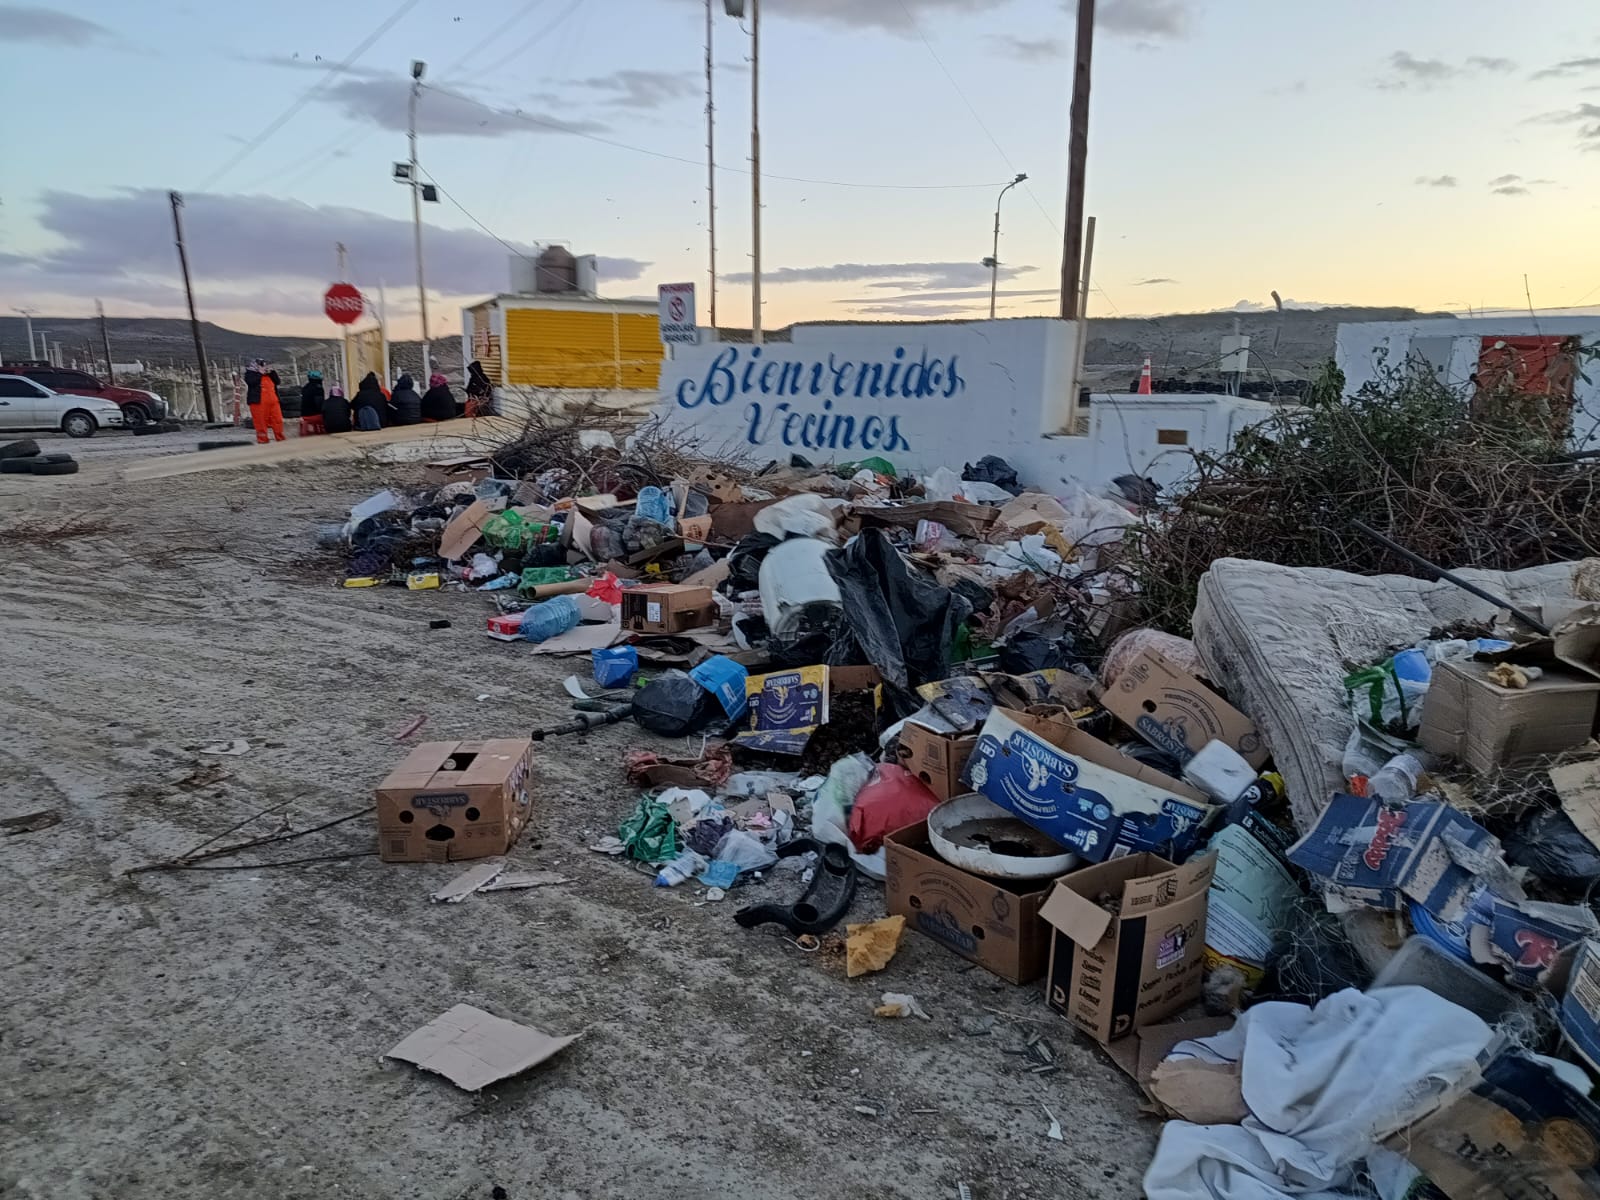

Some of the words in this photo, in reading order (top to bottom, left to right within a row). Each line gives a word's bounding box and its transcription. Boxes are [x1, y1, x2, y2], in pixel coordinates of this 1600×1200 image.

[326, 296, 362, 311] PARE
[676, 346, 966, 408] Bienvenidos
[743, 400, 911, 451] Vecinos
[1012, 733, 1075, 778] SABROSTAR
